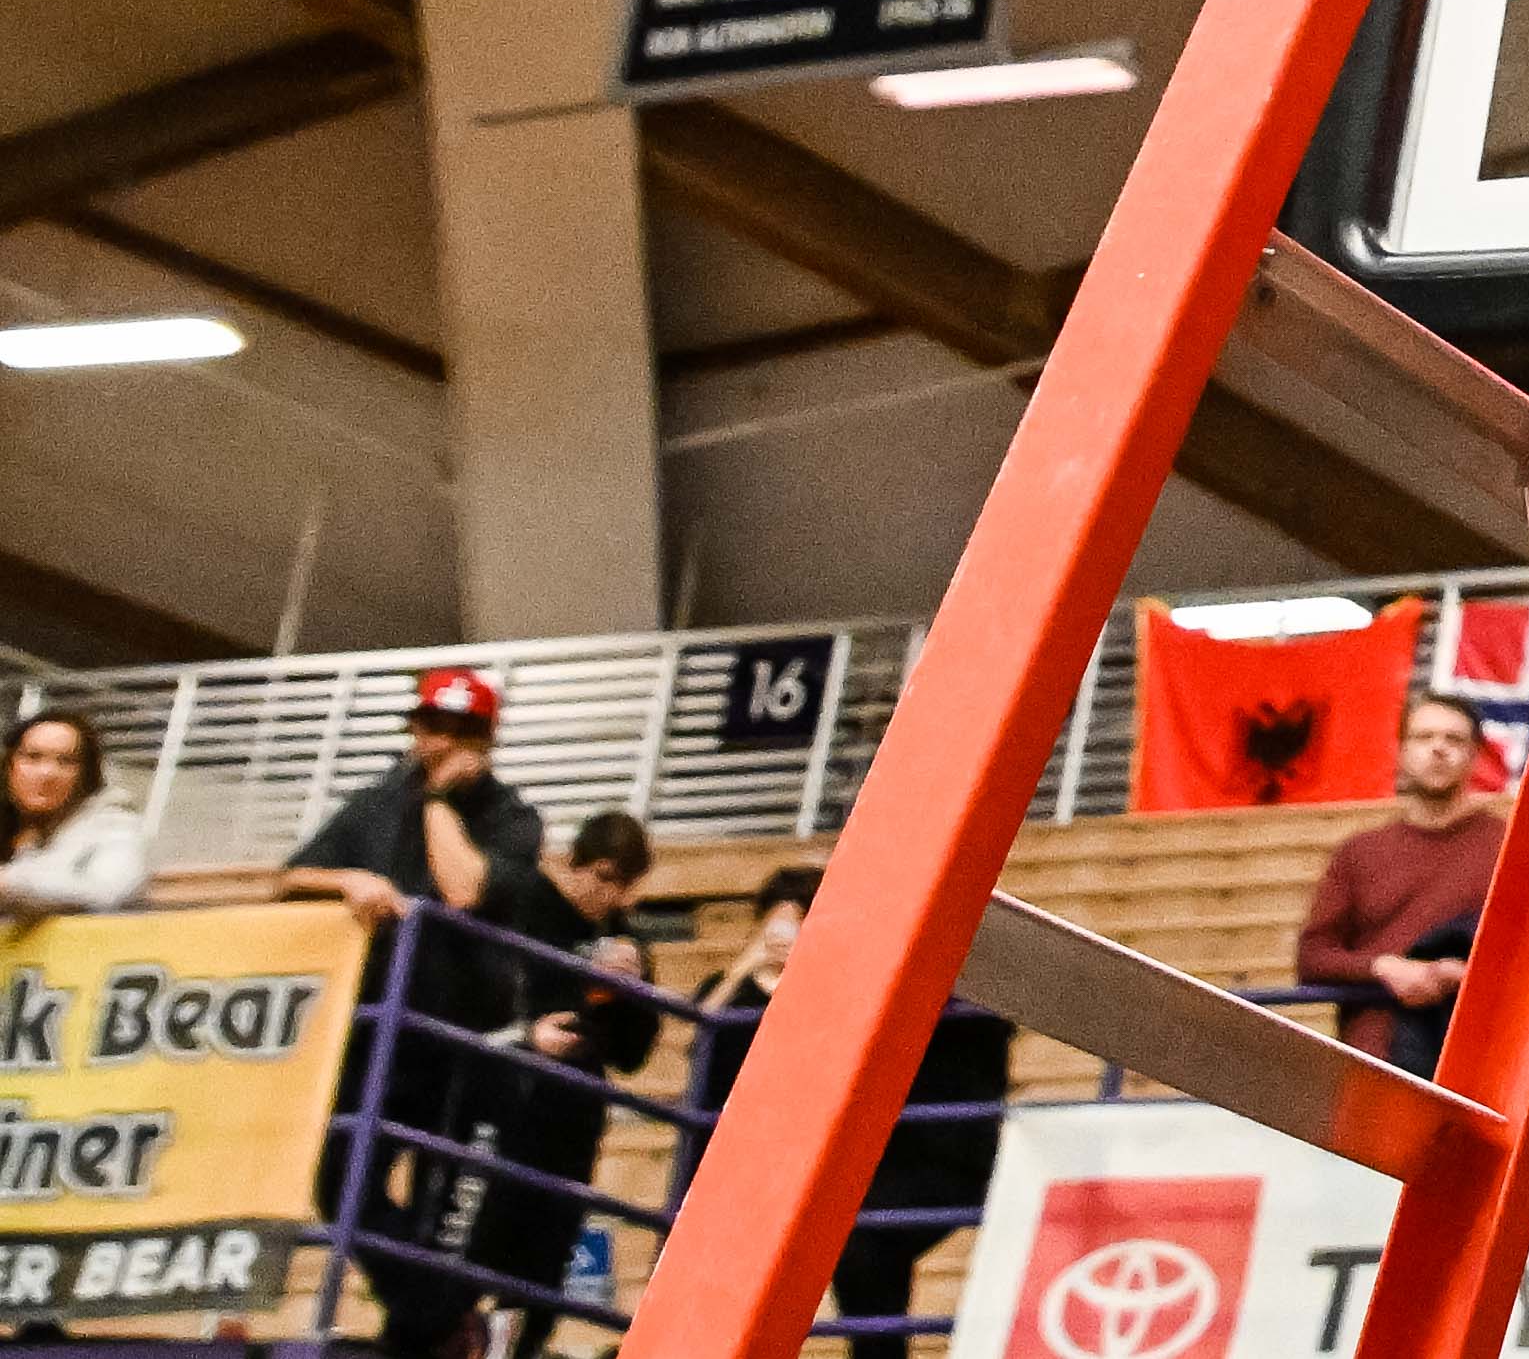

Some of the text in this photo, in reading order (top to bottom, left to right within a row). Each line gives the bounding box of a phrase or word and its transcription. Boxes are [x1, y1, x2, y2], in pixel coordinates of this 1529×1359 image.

[748, 657, 808, 723] 16
[86, 965, 325, 1063] Bear
[0, 1229, 261, 1305] R BEAR
